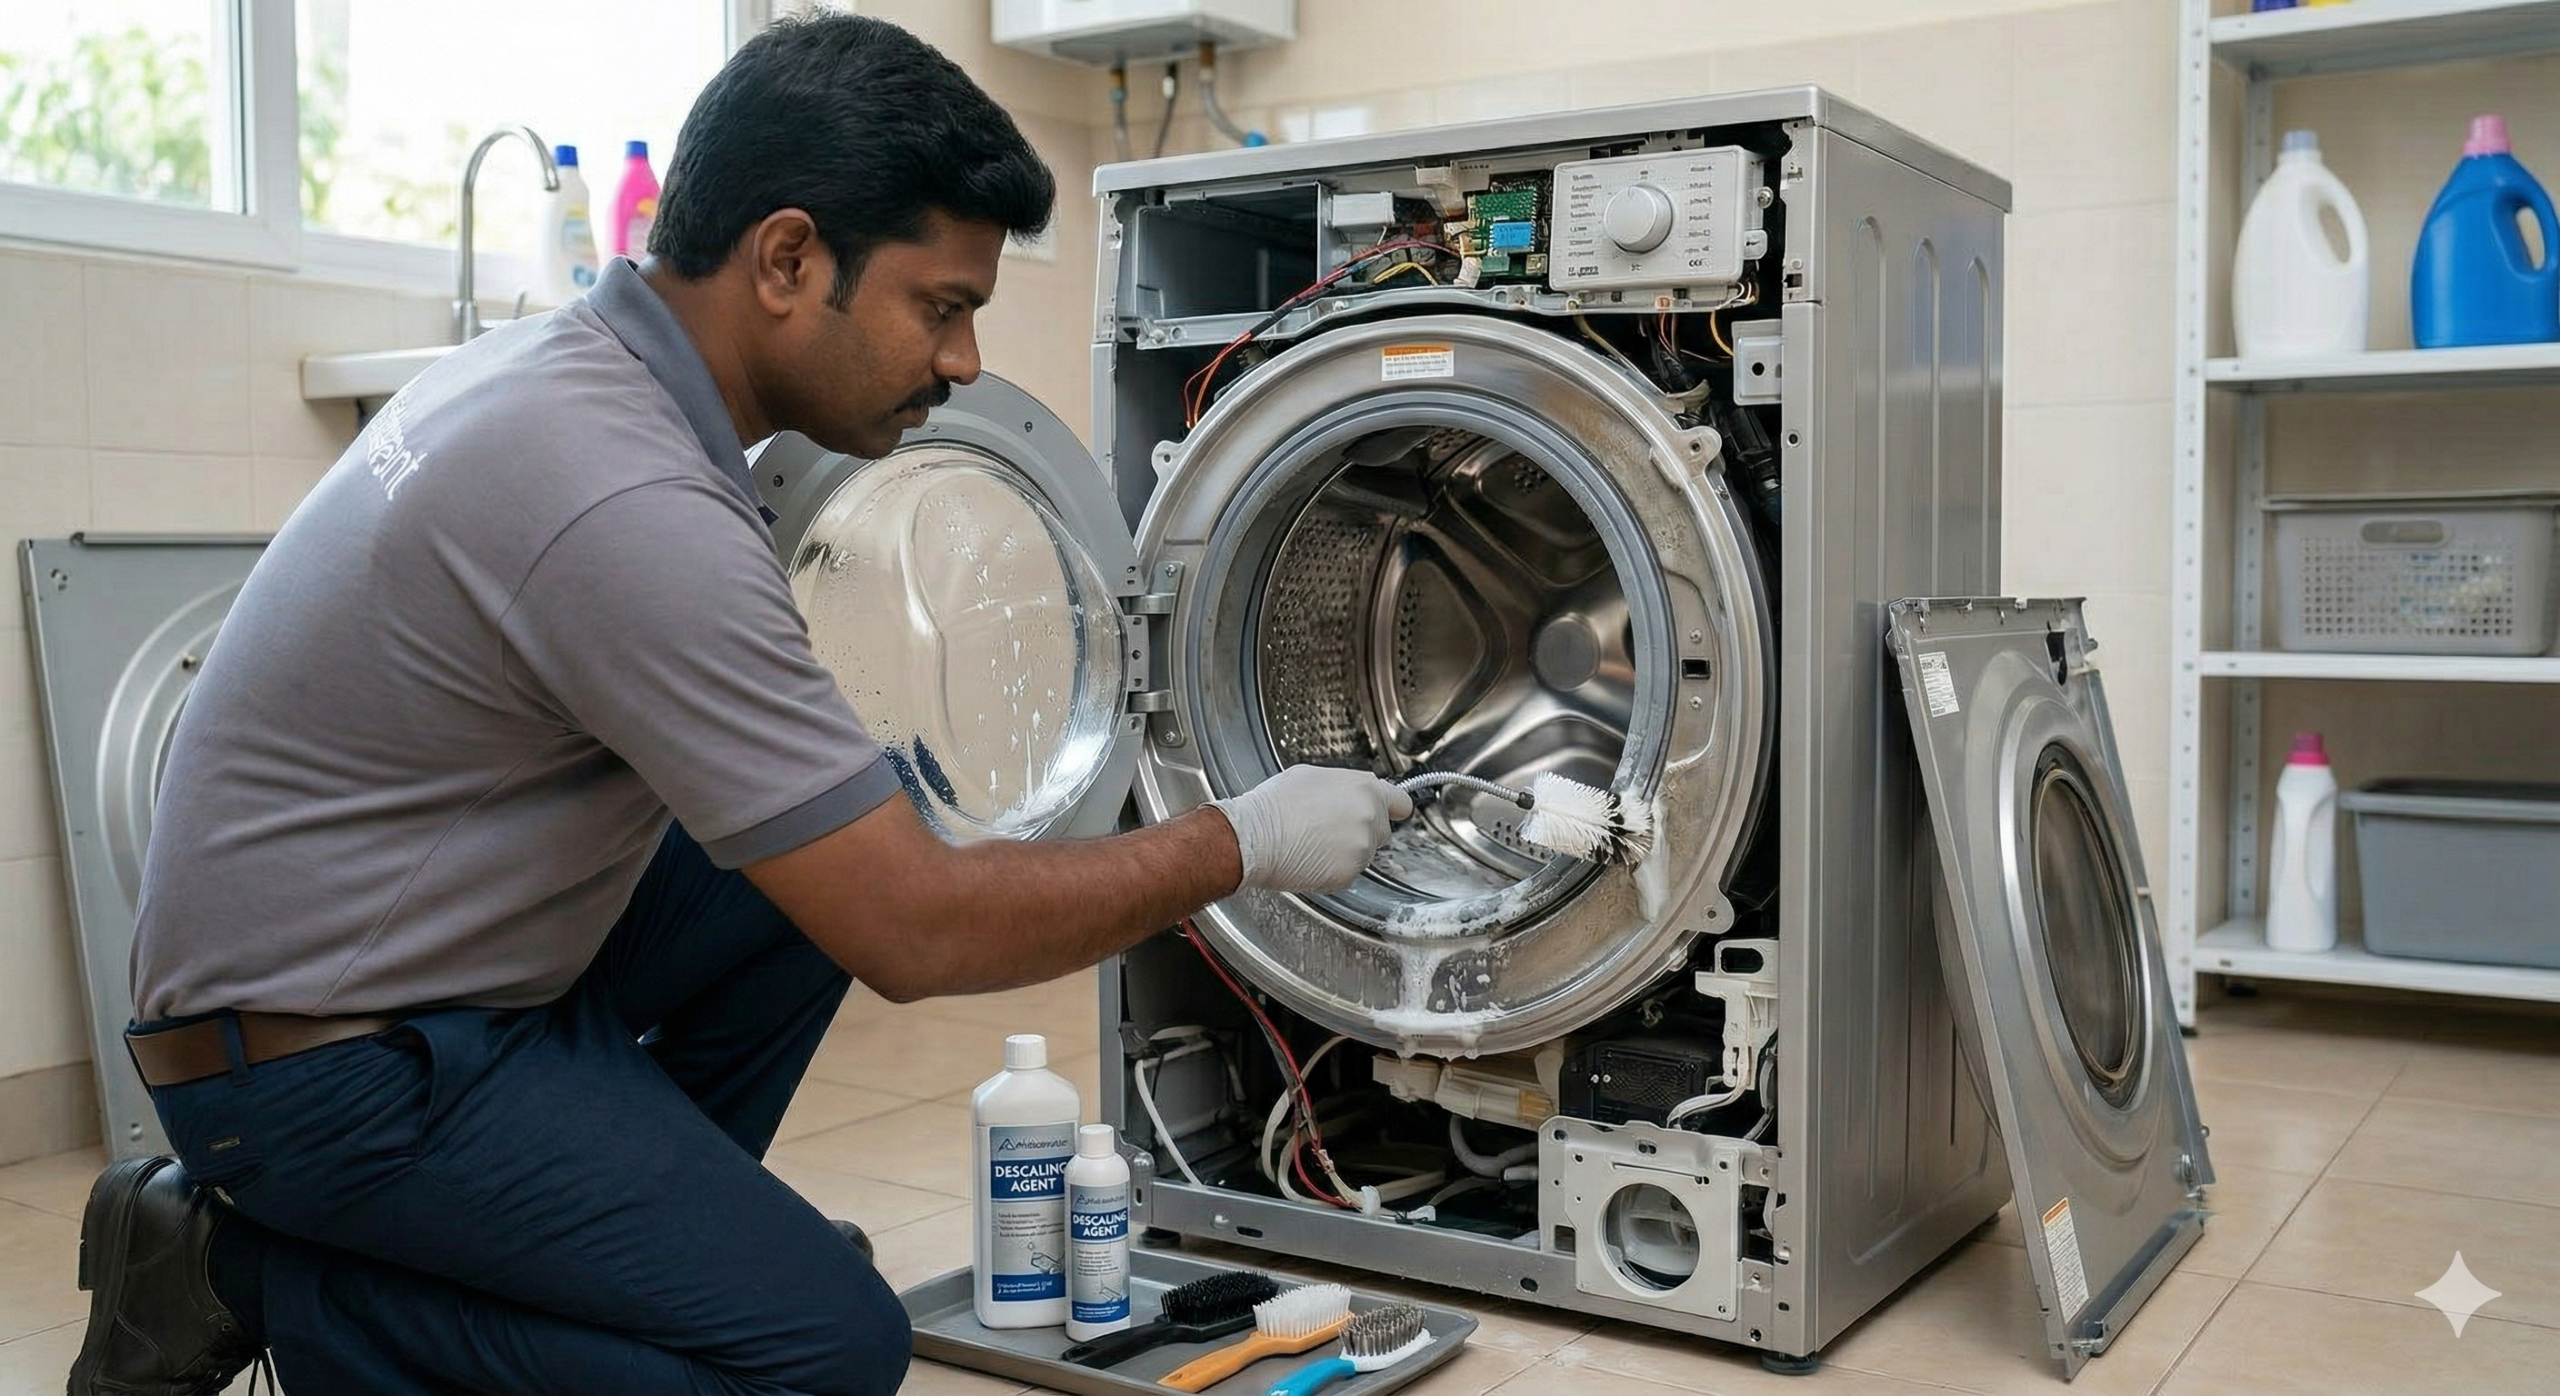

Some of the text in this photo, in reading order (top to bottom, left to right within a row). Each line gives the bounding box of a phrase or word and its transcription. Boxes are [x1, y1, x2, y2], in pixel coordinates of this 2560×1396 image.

[1010, 1177, 1057, 1193] AGENT
[1072, 1210, 1127, 1226] DESCALING
[1082, 1224, 1119, 1237] AGENT
